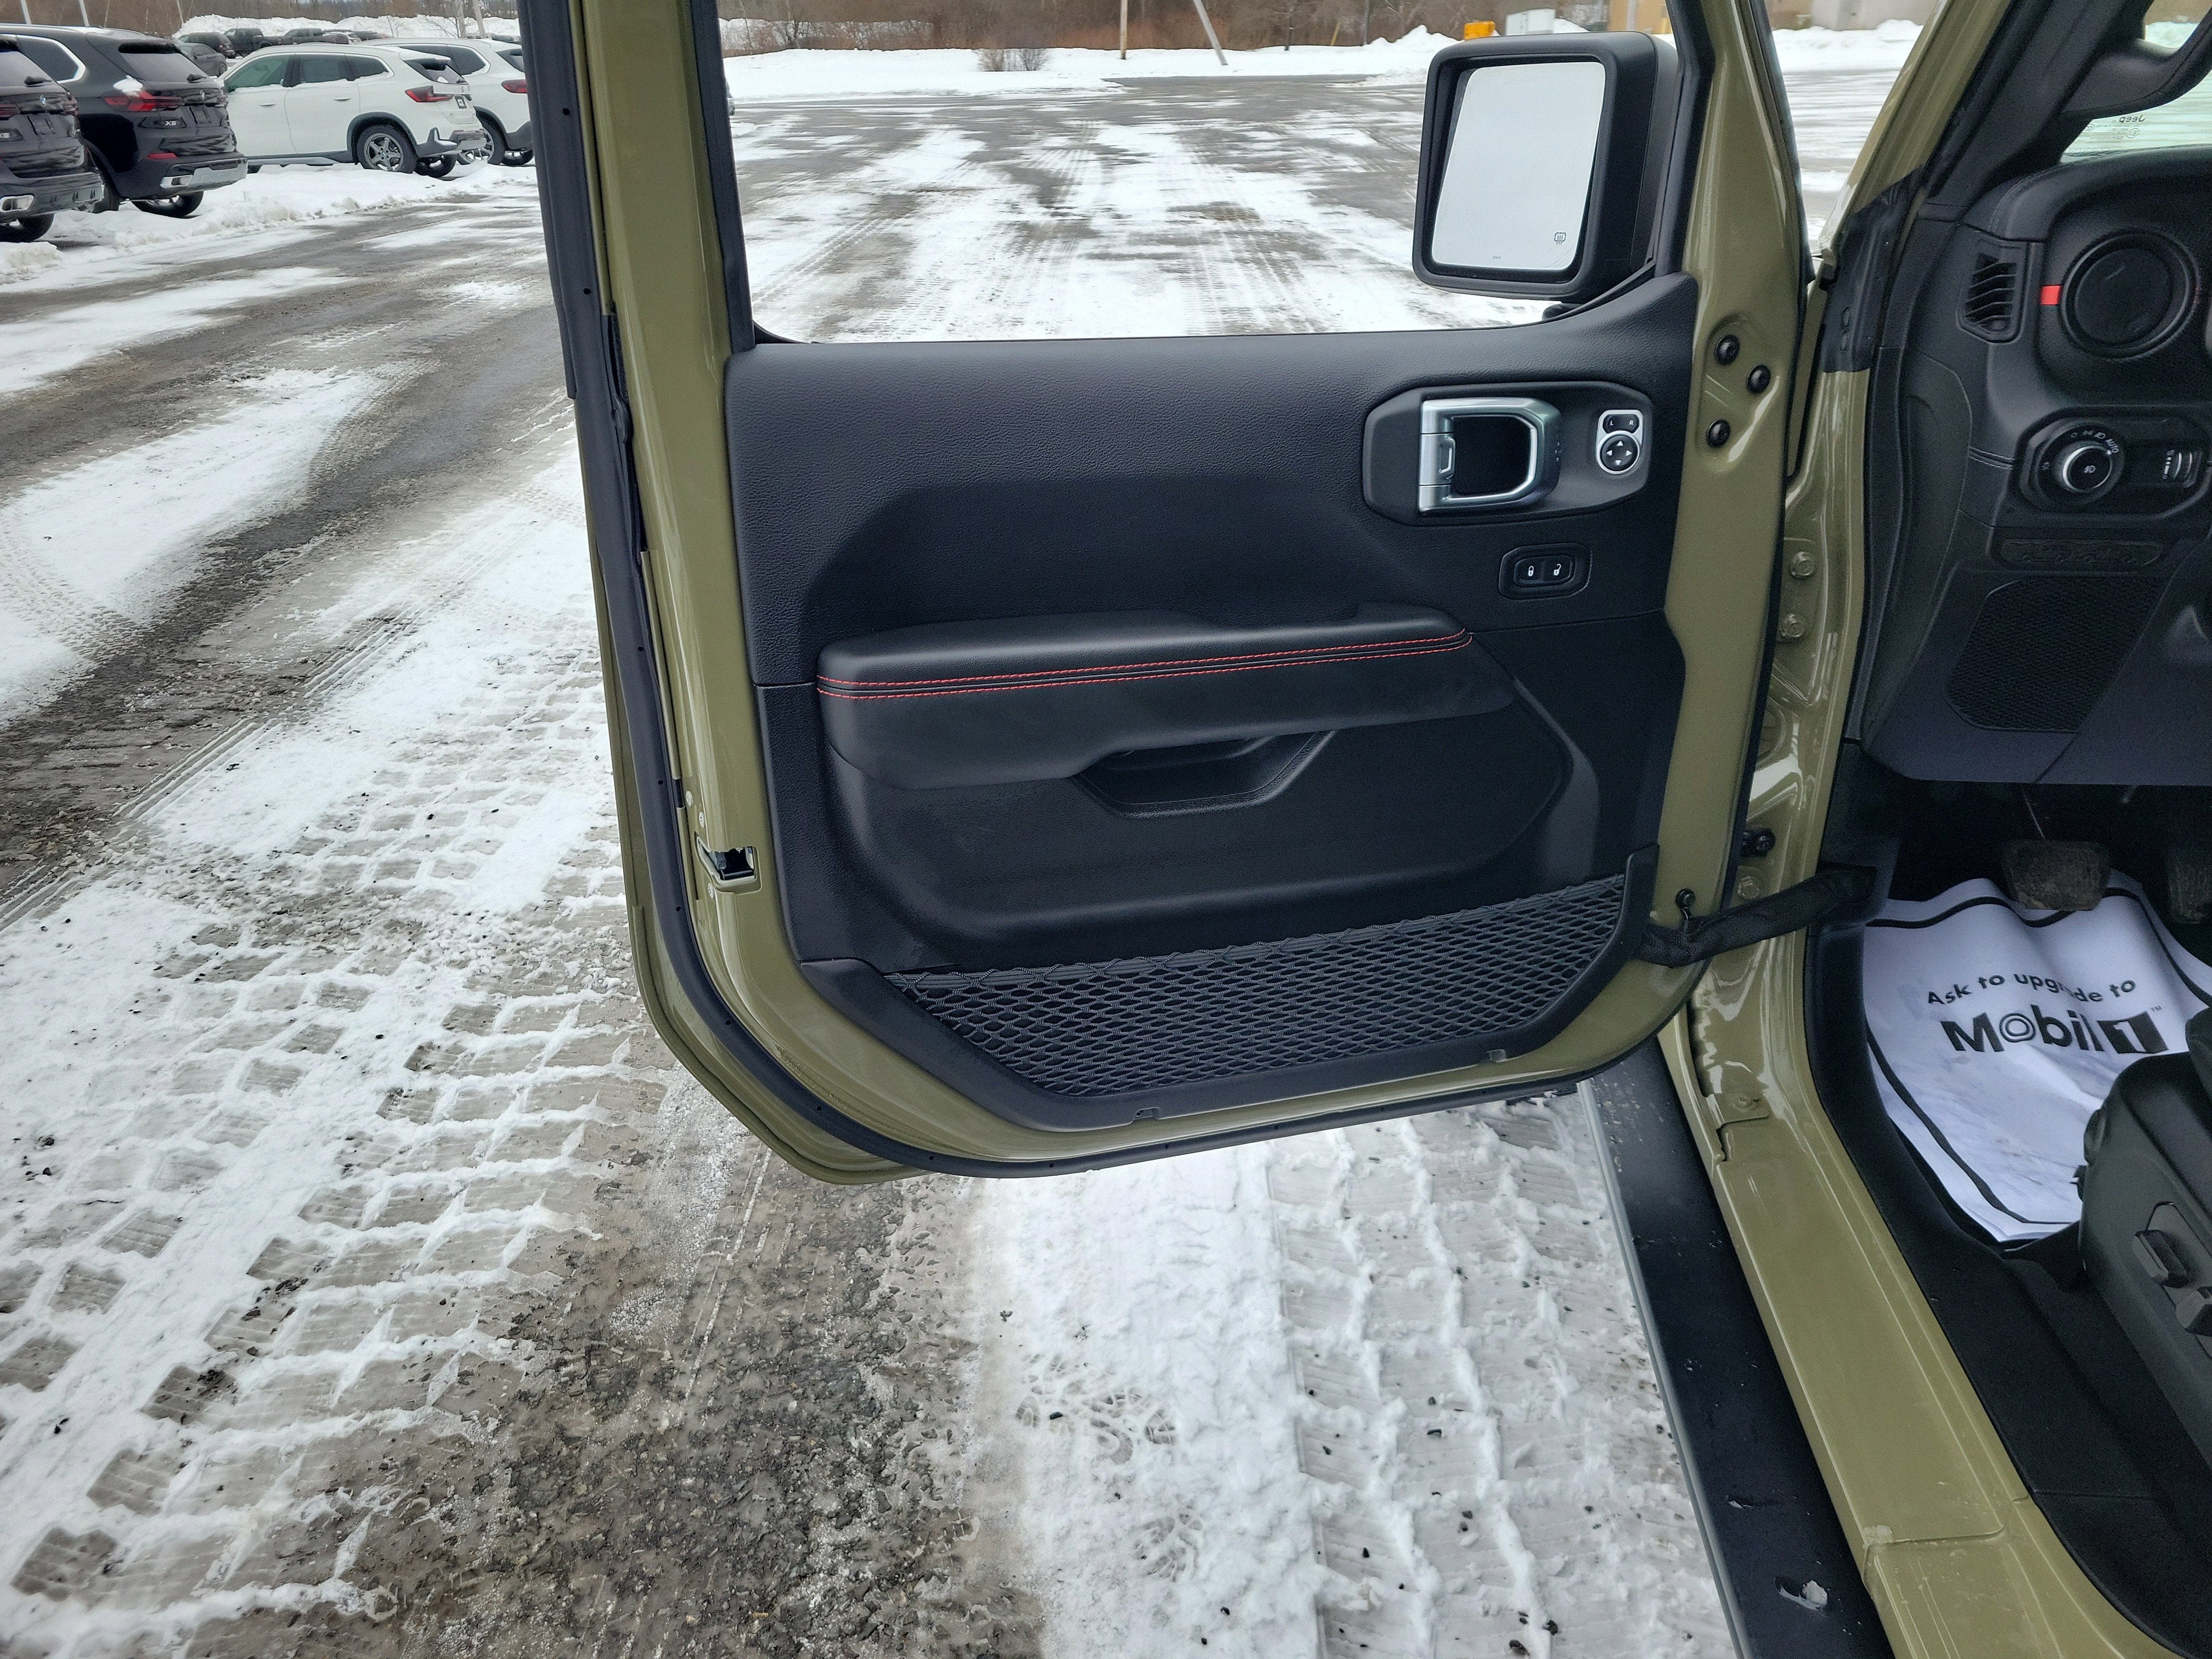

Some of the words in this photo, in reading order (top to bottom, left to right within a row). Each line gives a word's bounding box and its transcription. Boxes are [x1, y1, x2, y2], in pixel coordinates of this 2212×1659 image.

[2106, 438, 2119, 453] AUTO
[1928, 984, 1973, 1005] Ask
[1978, 975, 2005, 989] to
[2109, 980, 2136, 997] to
[1940, 1003, 2105, 1052] Mobil
